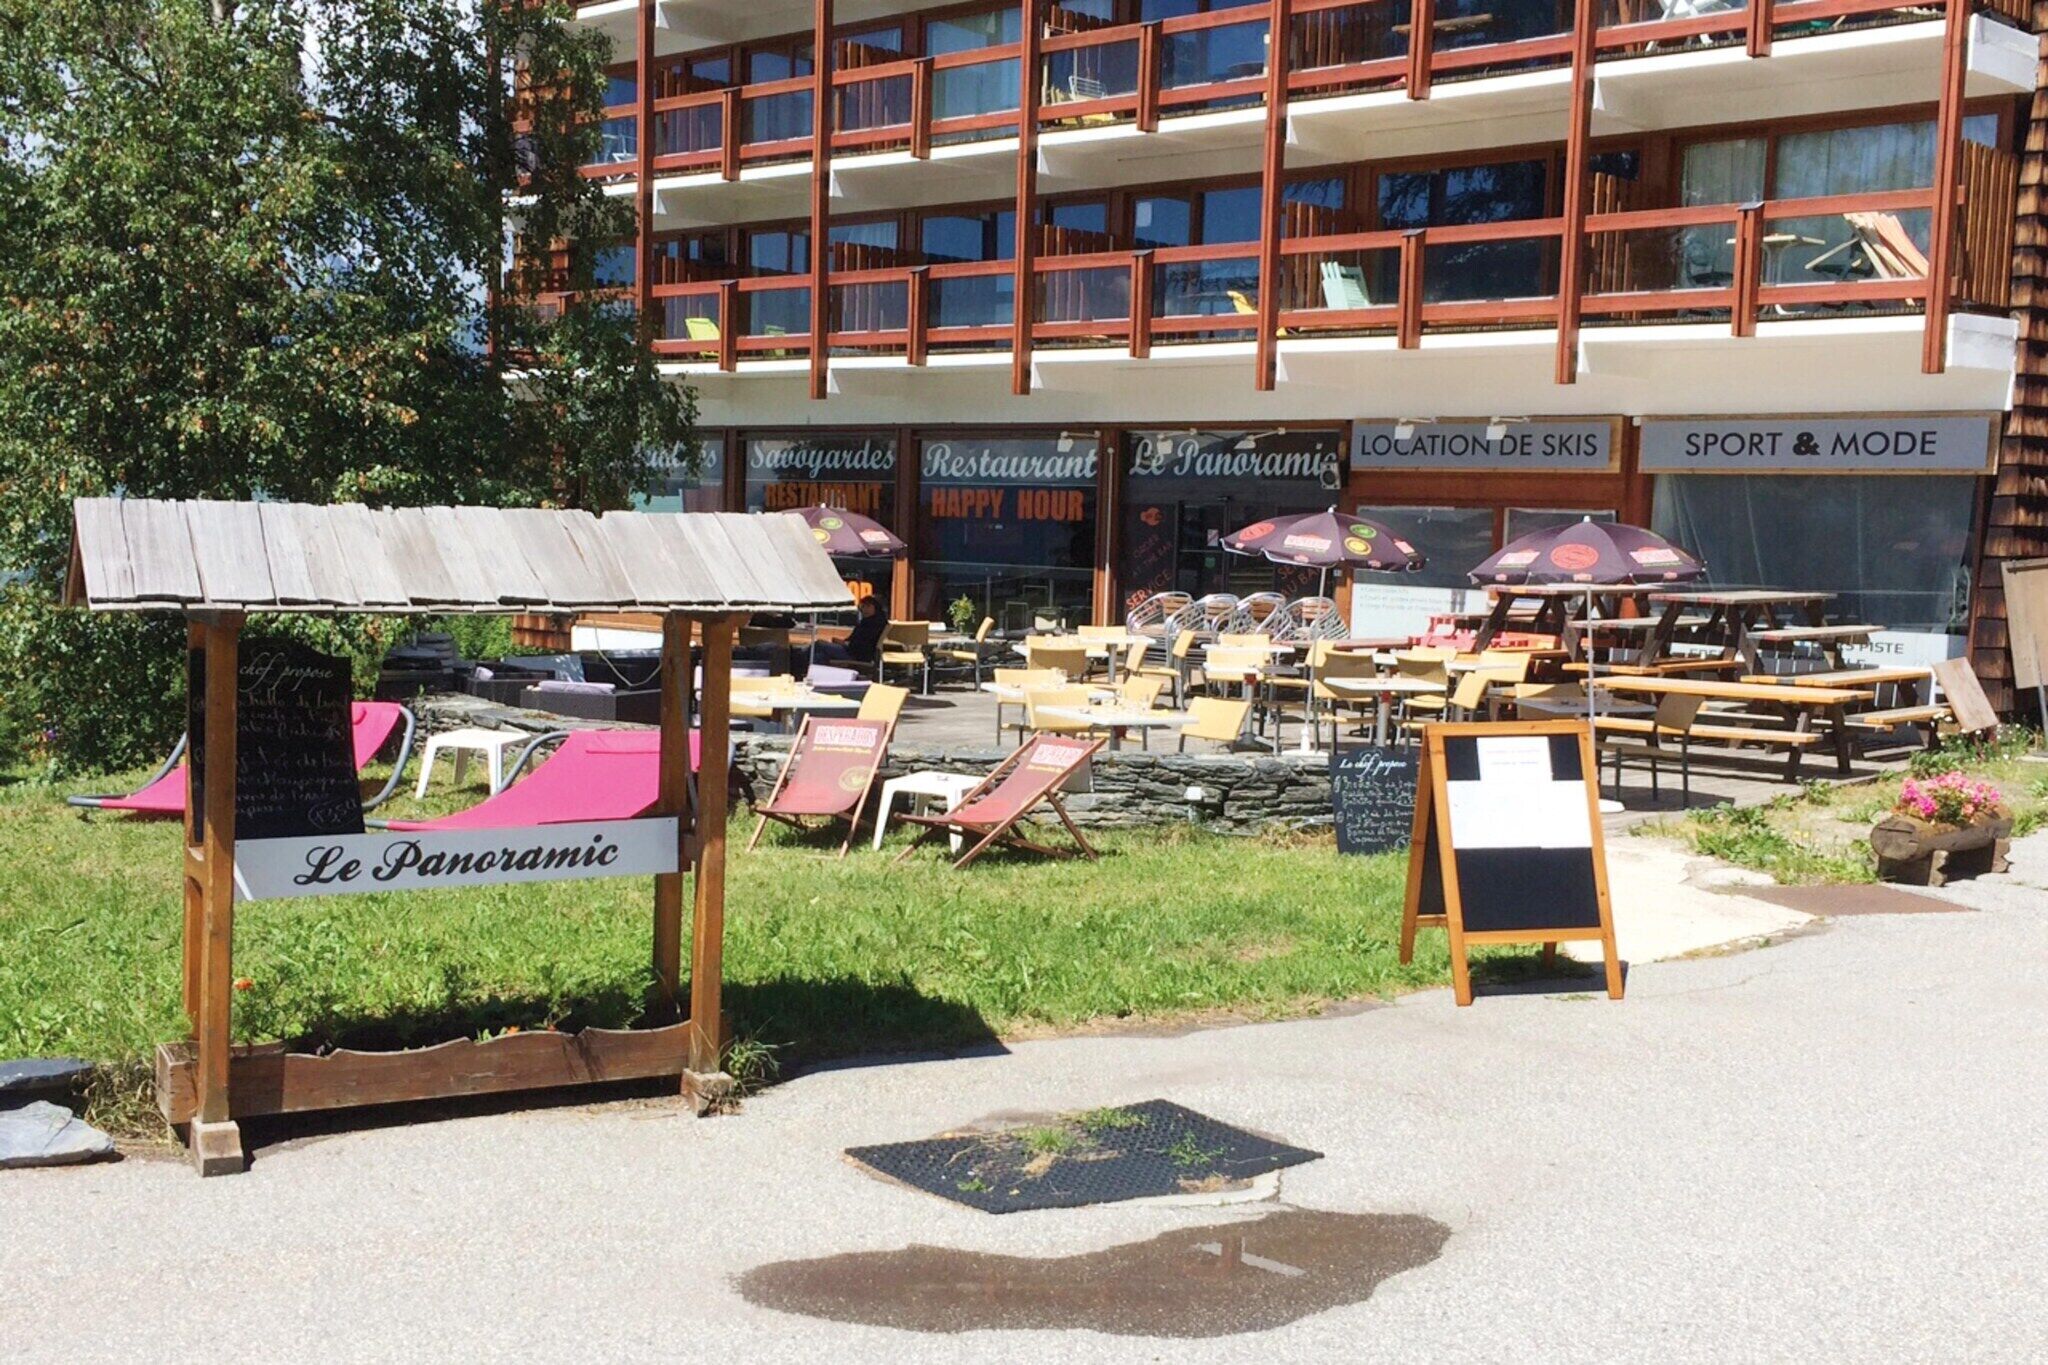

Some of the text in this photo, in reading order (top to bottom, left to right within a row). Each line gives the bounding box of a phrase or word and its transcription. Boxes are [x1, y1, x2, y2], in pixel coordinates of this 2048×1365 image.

[750, 439, 896, 479] Savoyardes
[923, 442, 1097, 479] Restaurant
[1129, 437, 1338, 482] Le Panoramic
[1360, 432, 1598, 456] LOCATION DE SKIS
[1685, 430, 1937, 457] SPORT & MODE
[931, 488, 1084, 521] HAPPY HOUR
[272, 664, 334, 692] propose
[293, 833, 620, 886] Le Panoramic
